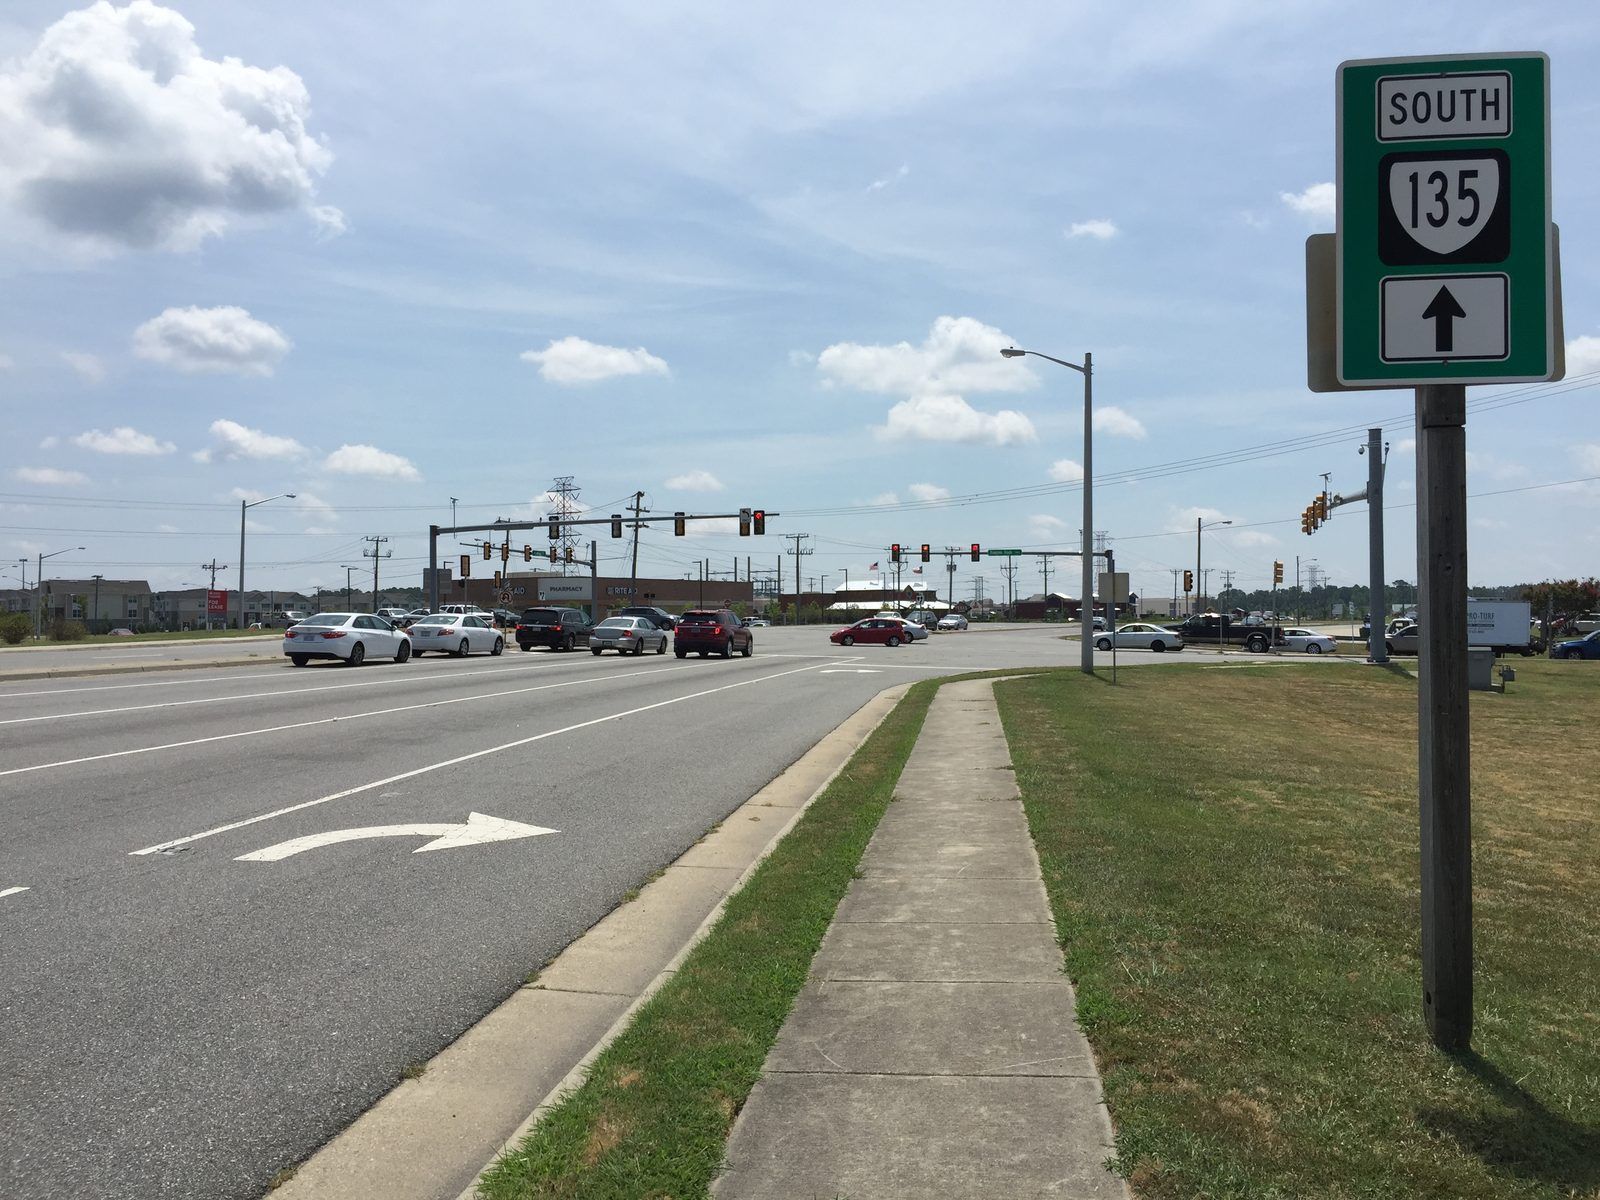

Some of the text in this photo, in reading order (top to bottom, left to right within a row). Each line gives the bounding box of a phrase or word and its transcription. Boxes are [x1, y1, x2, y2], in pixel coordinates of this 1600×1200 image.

[1389, 88, 1500, 125] SOUTH
[1409, 169, 1480, 228] 135
[614, 587, 628, 595] RITE
